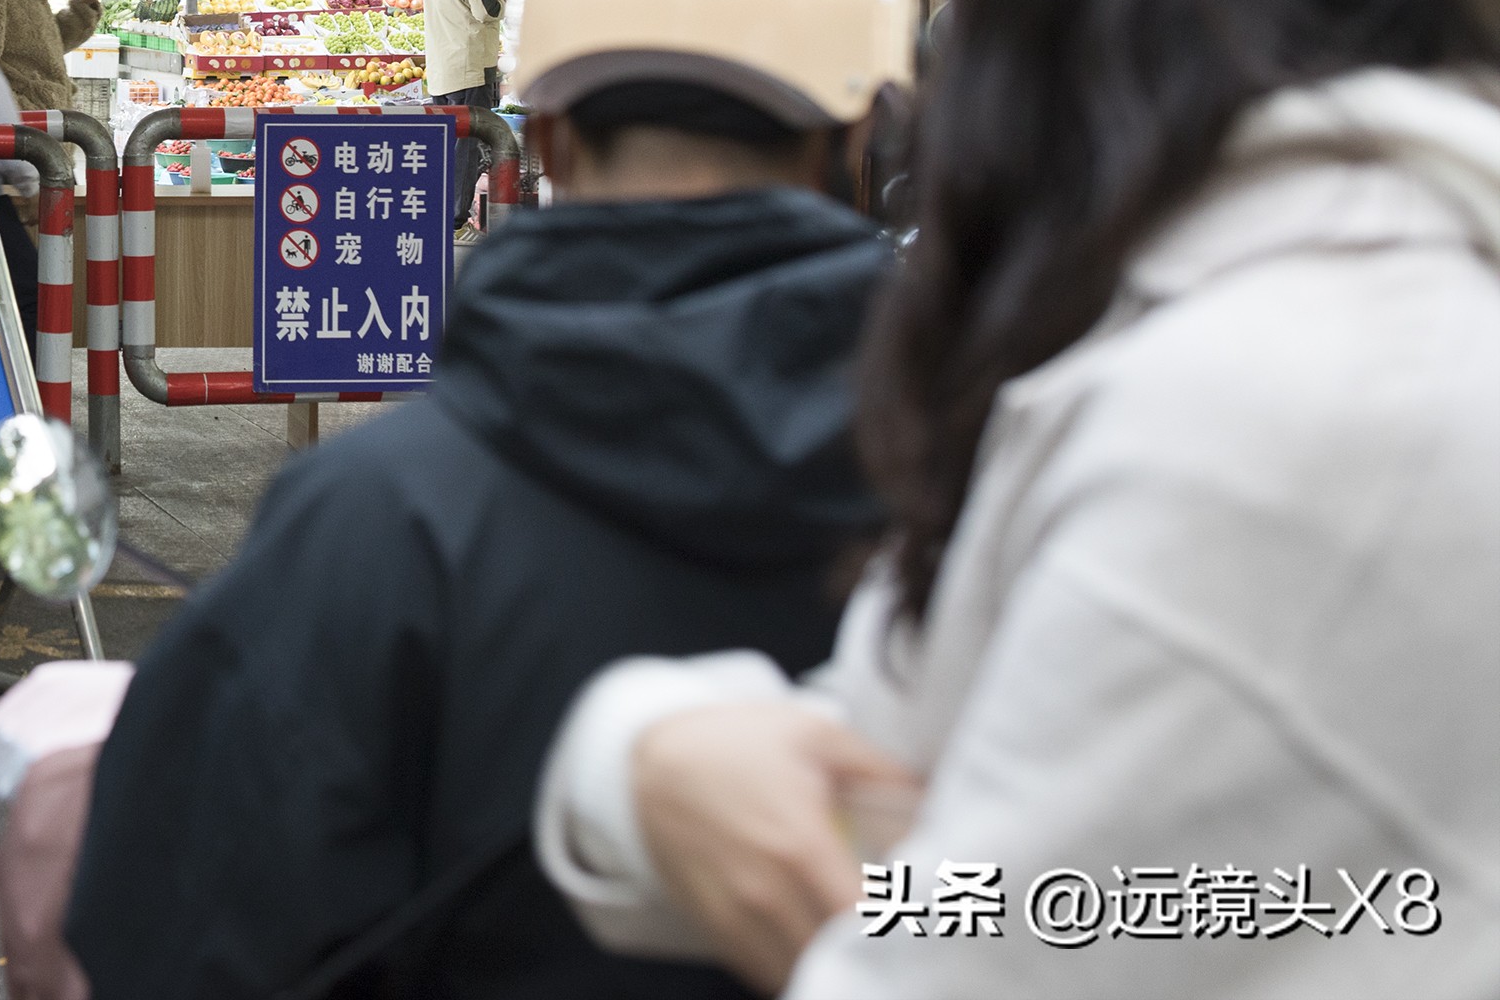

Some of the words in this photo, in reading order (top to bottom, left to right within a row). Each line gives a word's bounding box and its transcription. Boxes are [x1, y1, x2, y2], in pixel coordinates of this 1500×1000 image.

[333, 141, 428, 175] 电动车
[334, 186, 428, 221] 自行车
[335, 232, 424, 266] 宠物
[275, 285, 430, 342] 禁止入内
[357, 352, 433, 374] 谢谢配合
